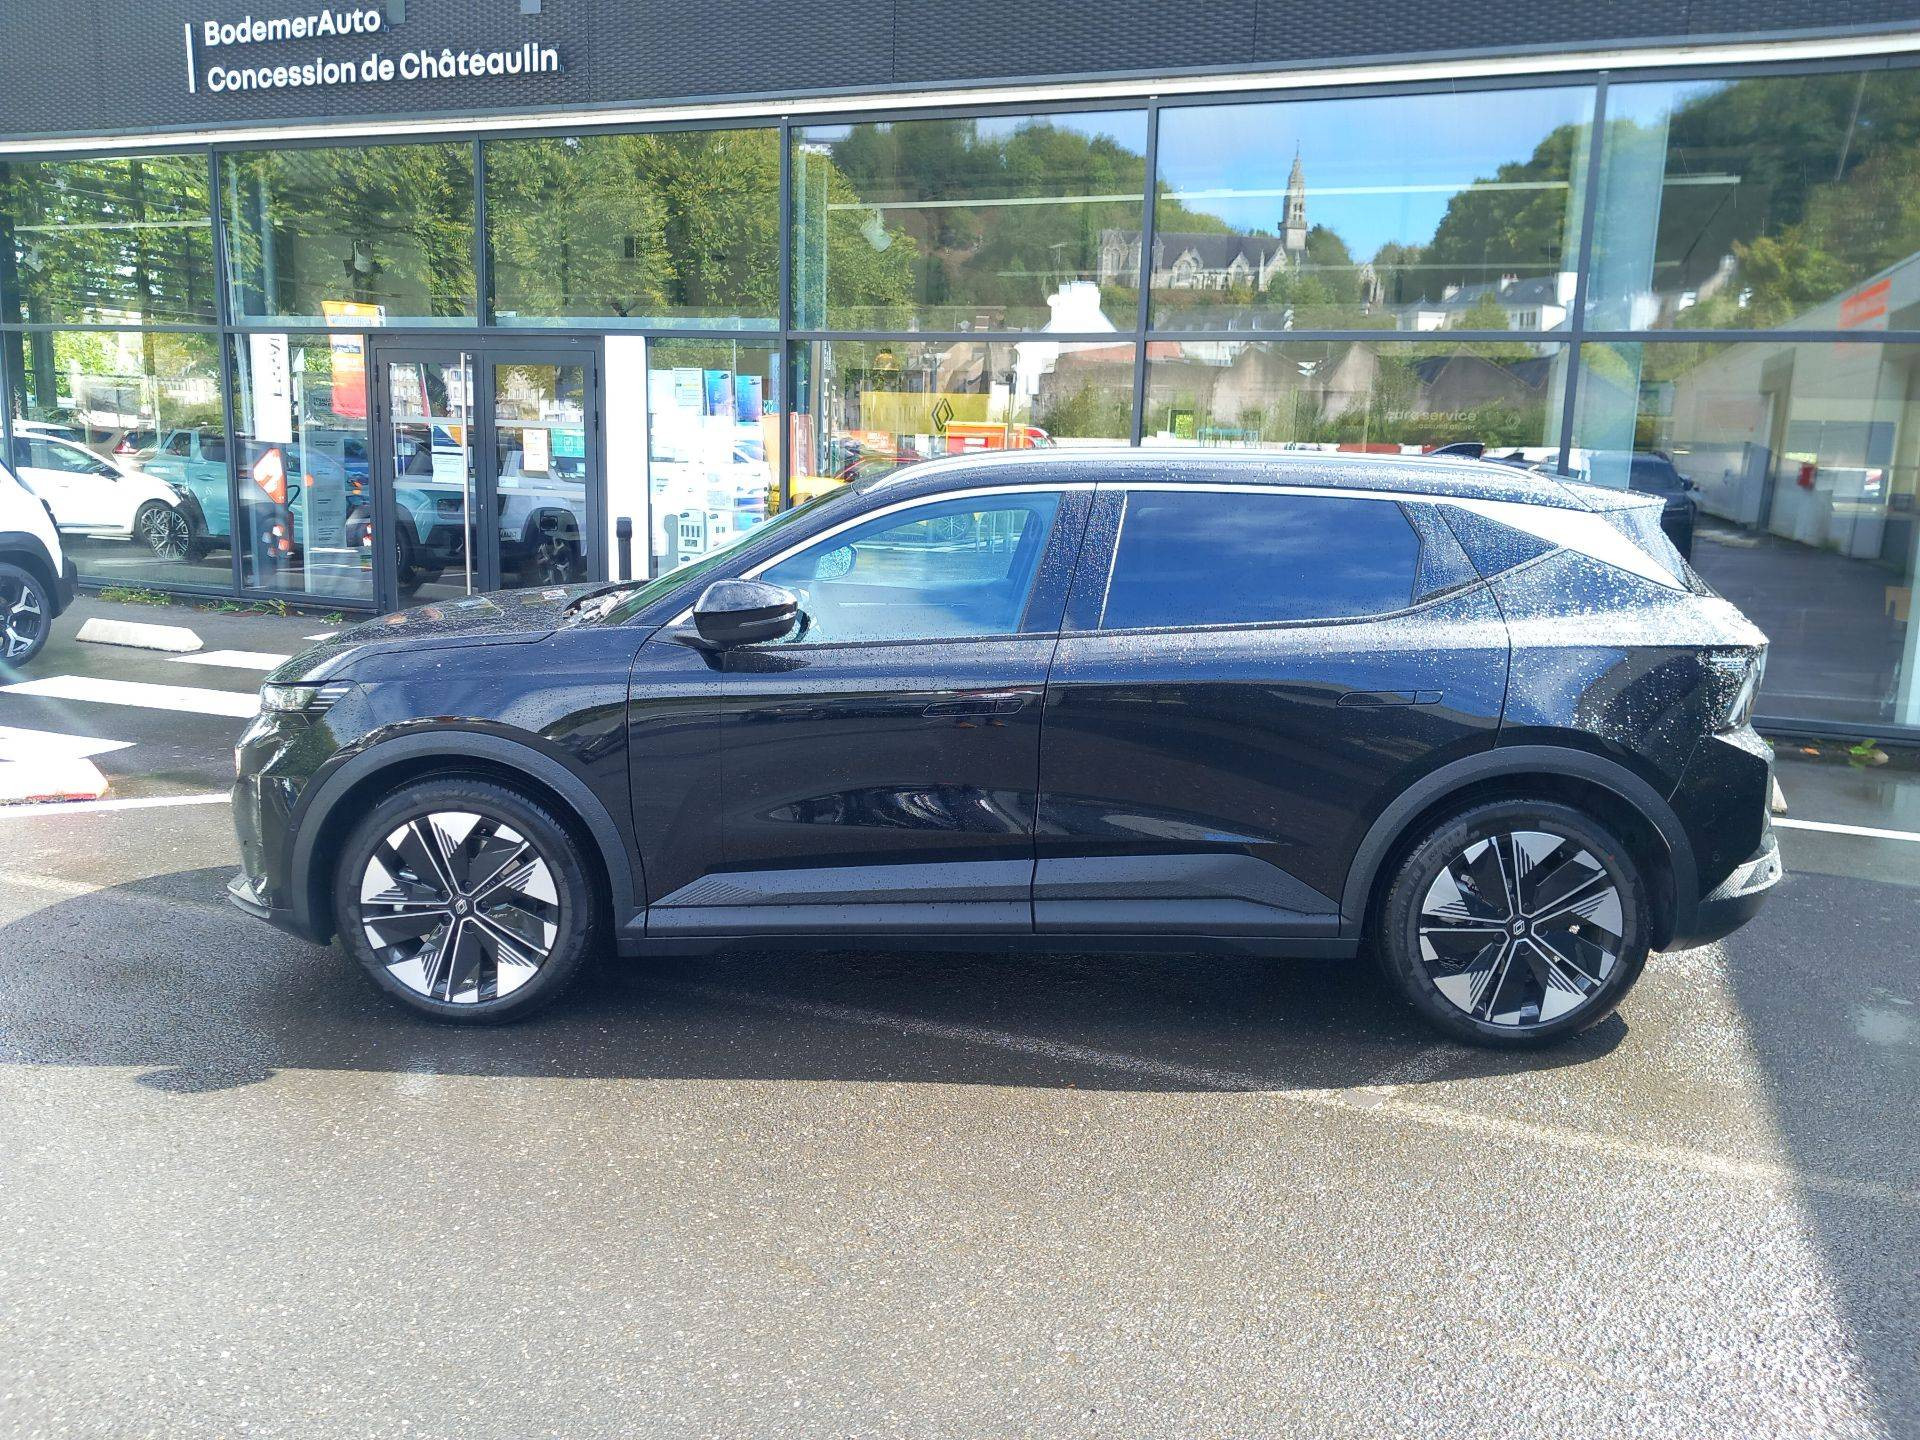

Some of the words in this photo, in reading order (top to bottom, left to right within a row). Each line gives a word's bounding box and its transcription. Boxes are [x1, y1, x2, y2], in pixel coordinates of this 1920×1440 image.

[204, 8, 381, 46] BodemerAuto
[207, 57, 356, 92] Concession
[361, 53, 395, 81] de
[399, 42, 558, 80] Châteaulin
